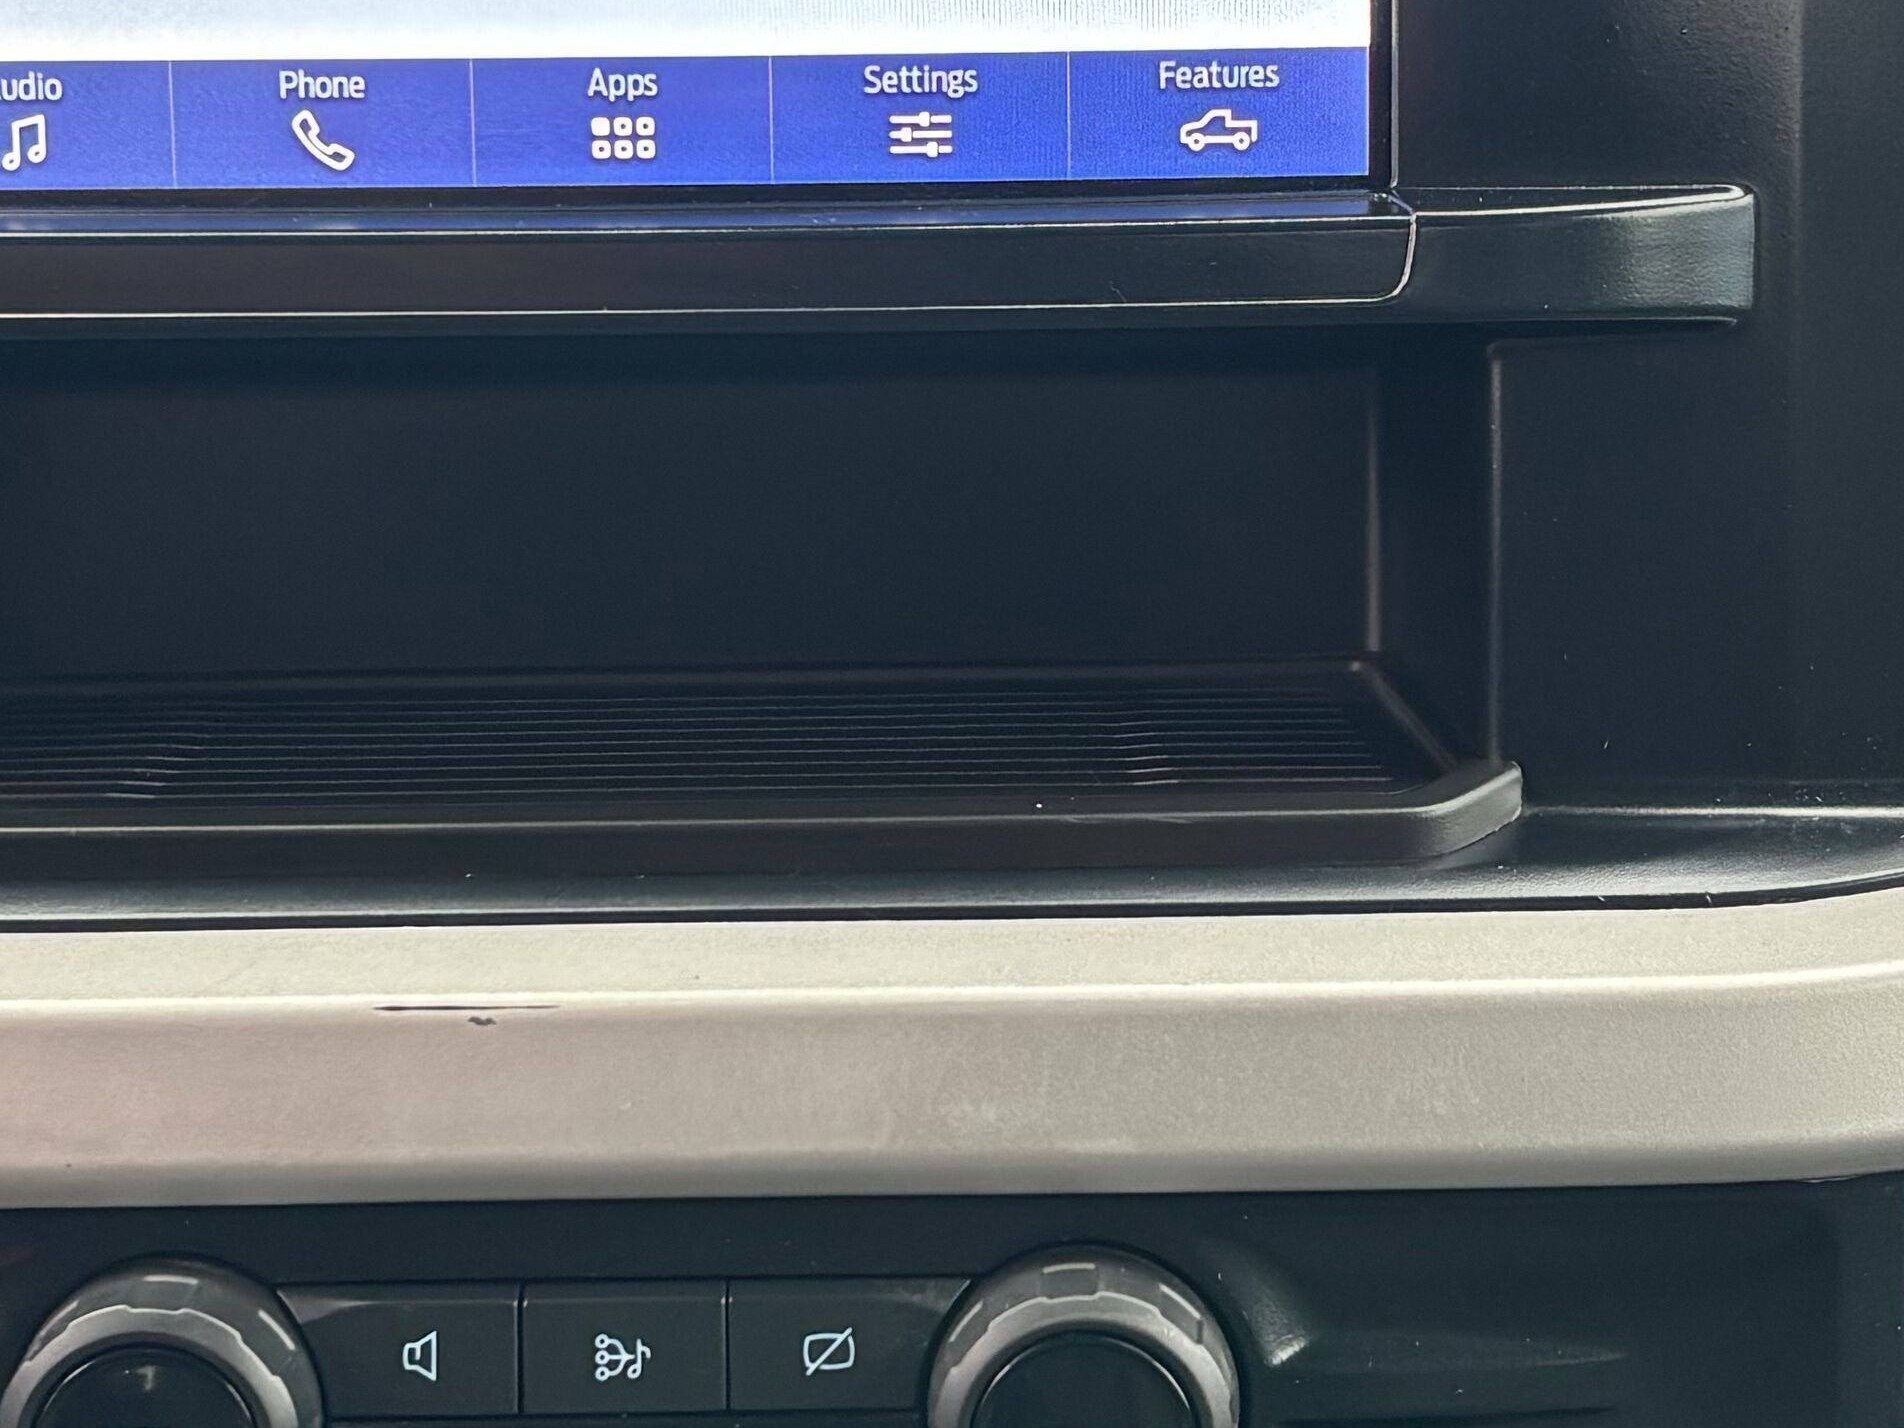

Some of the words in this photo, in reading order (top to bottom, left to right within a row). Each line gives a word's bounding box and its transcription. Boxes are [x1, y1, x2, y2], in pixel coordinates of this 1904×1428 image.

[279, 69, 366, 99] Phone
[587, 67, 658, 100] Apps
[863, 64, 978, 98] Settings
[1159, 60, 1280, 89] Features
